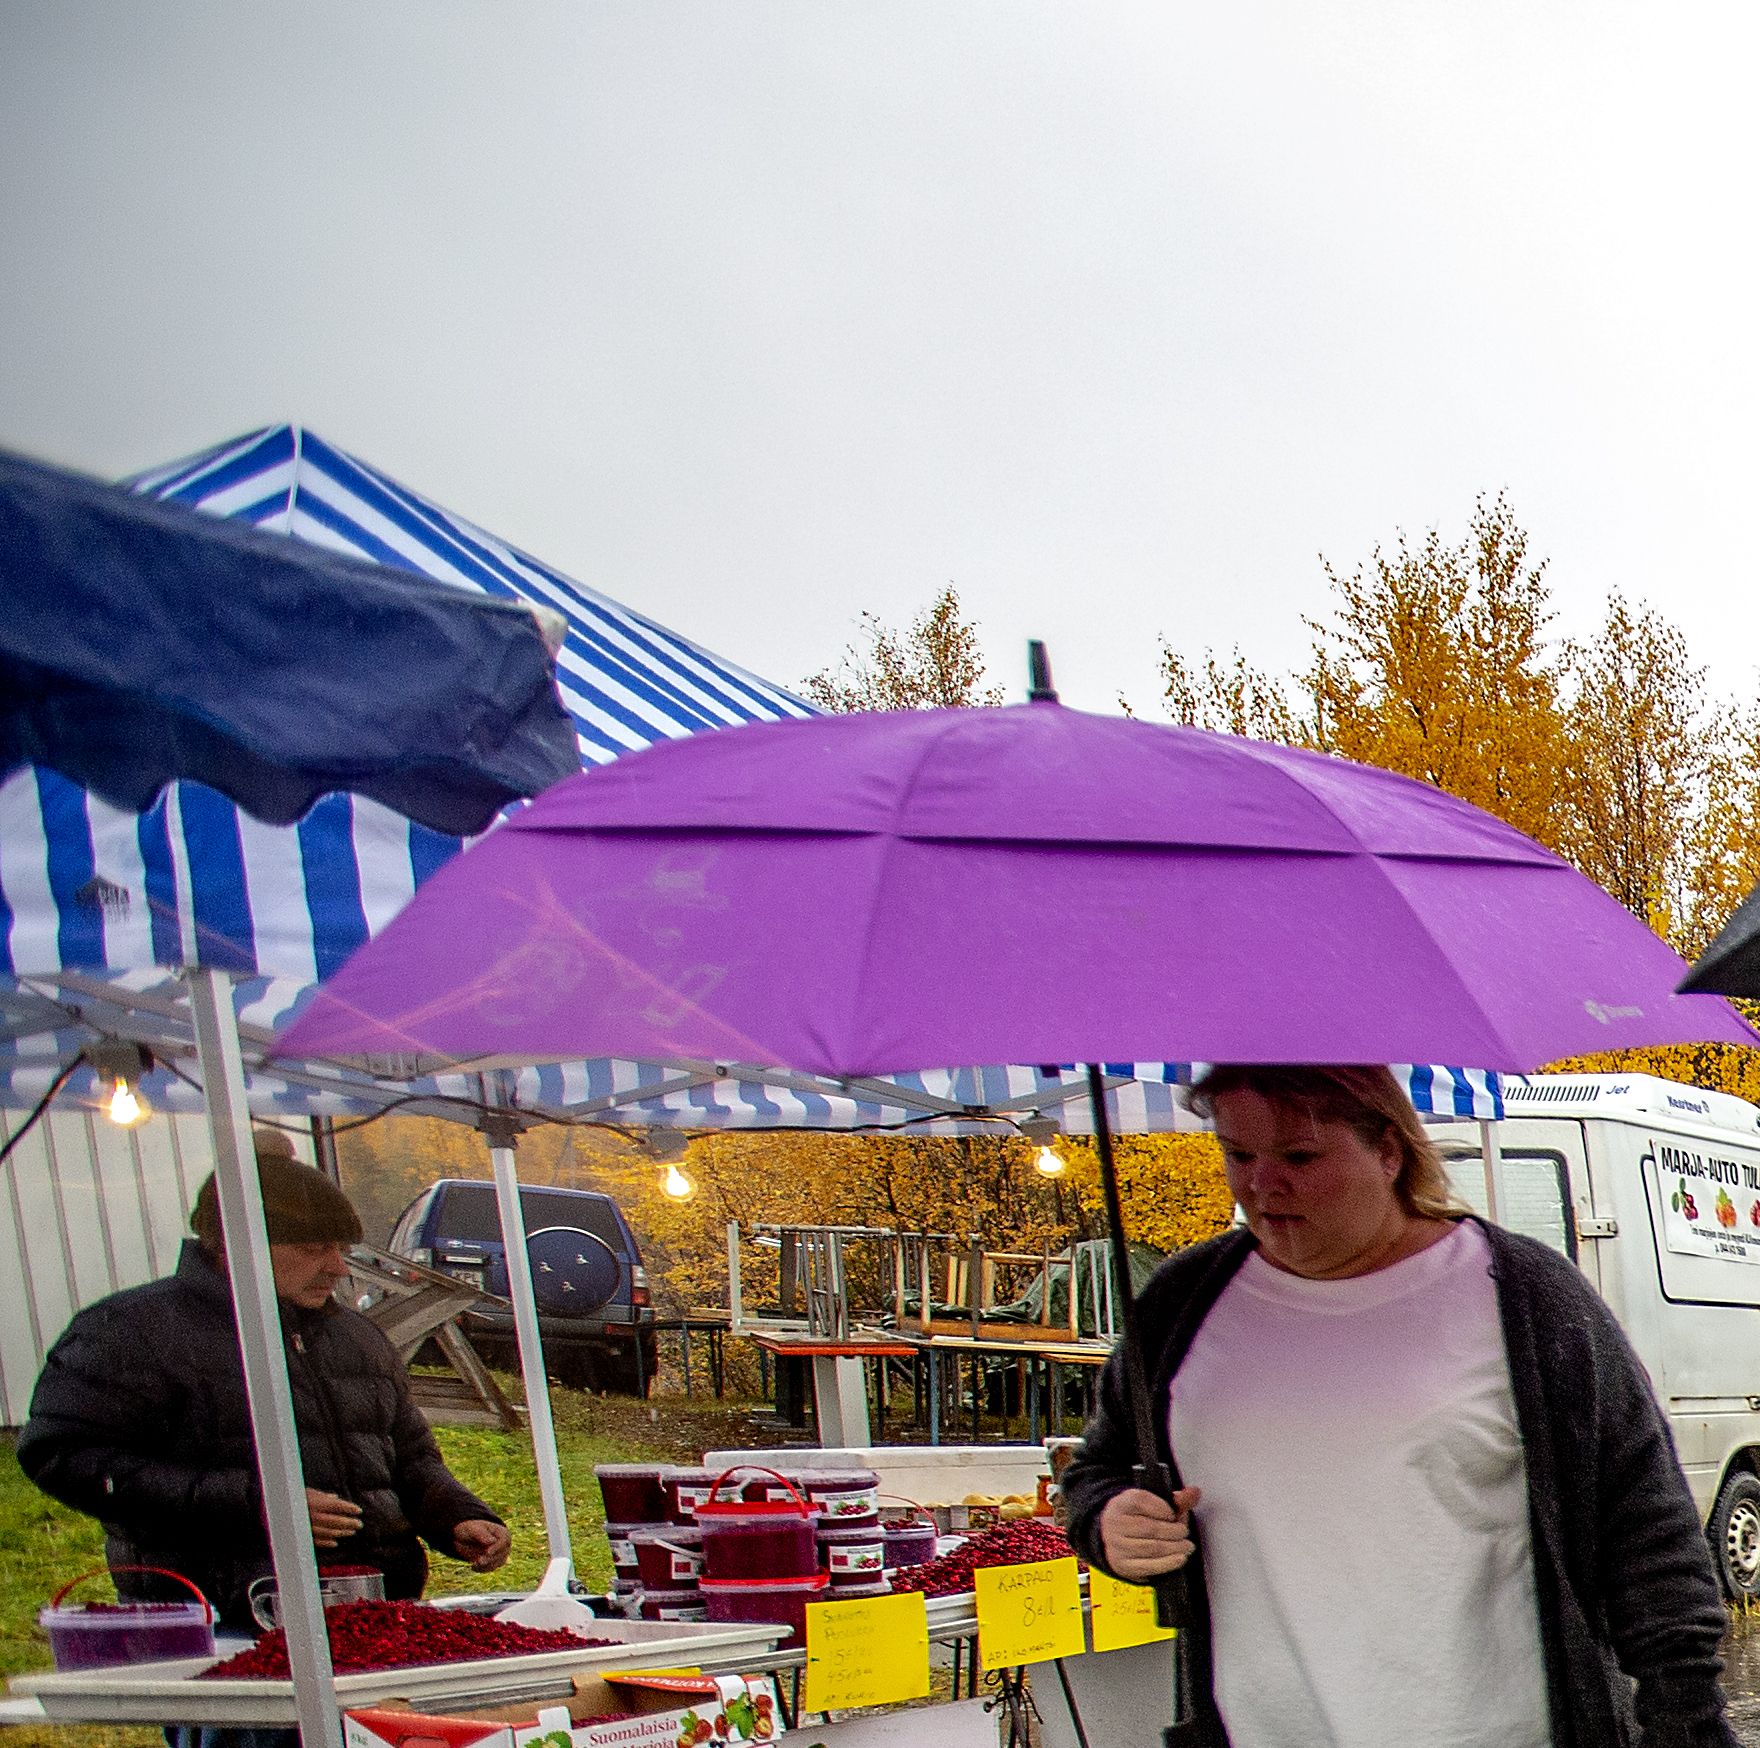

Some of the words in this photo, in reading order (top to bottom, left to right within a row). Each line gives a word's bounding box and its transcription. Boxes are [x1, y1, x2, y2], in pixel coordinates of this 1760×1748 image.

[1606, 1085, 1630, 1095] Jet
[1661, 1147, 1739, 1186] MARJA-AUTO
[590, 1719, 678, 1746] Suomalaisia
